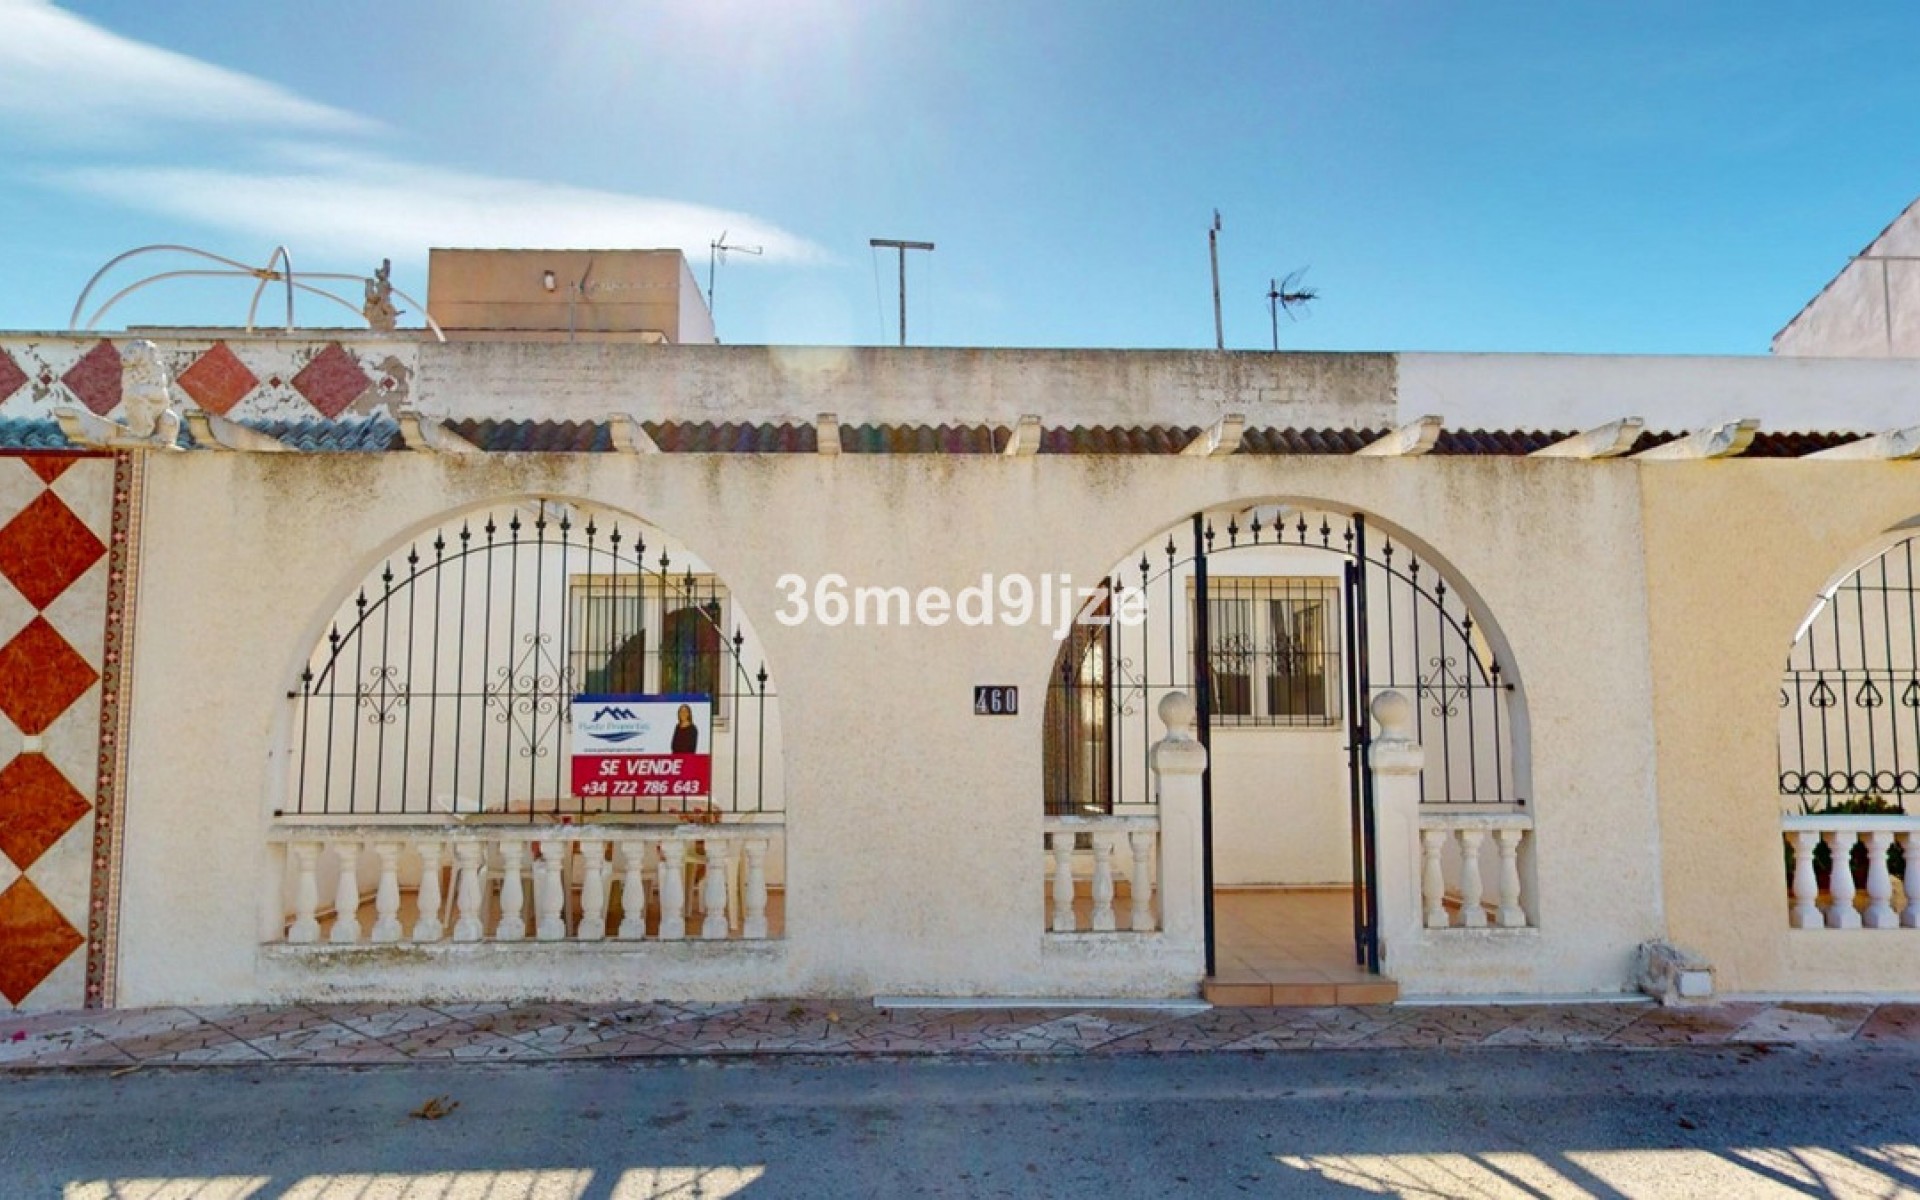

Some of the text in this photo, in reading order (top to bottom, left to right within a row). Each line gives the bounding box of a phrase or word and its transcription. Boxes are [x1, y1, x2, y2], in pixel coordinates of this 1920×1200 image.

[976, 687, 1017, 712] 460
[598, 759, 684, 775] SE VENDE
[582, 780, 700, 794] +34 722 786 643
